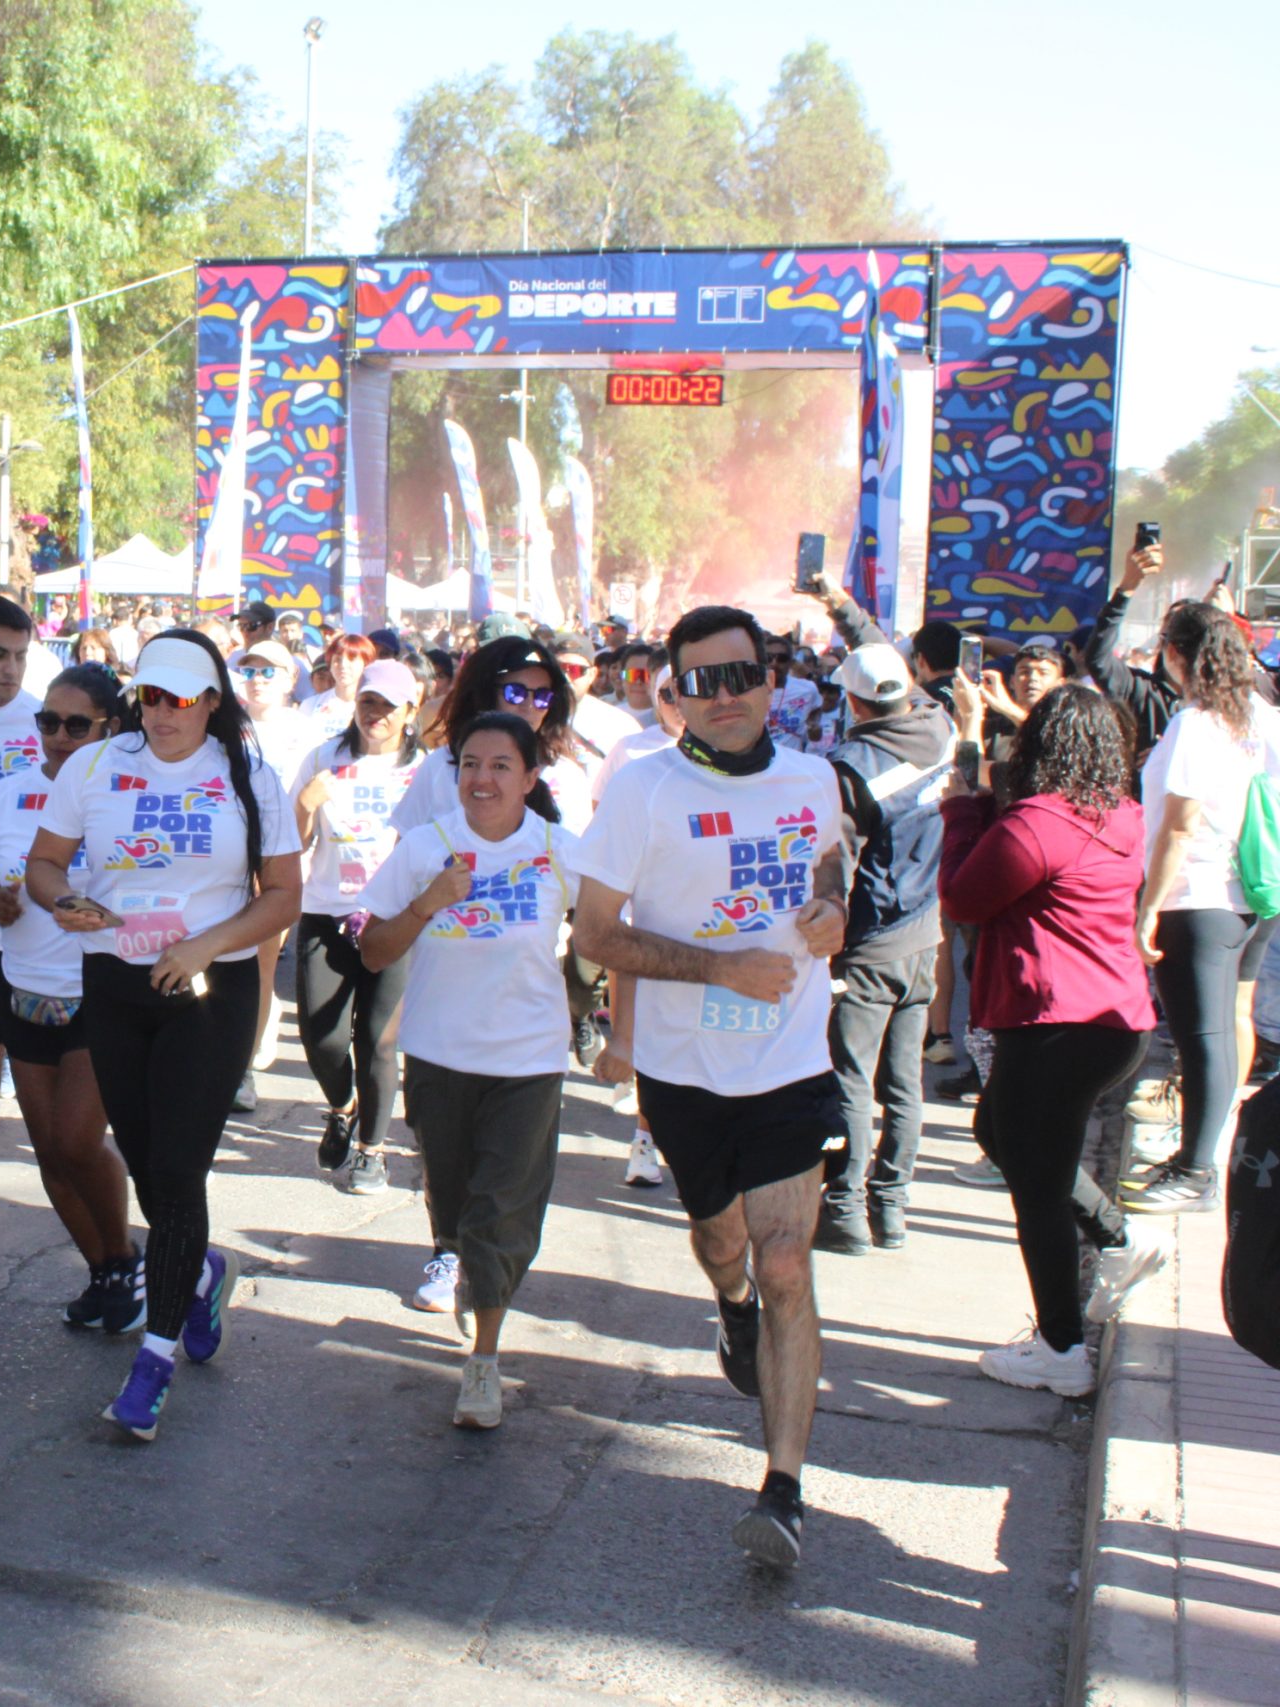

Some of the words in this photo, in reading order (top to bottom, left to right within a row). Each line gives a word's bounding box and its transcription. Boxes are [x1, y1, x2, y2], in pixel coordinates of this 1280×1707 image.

[508, 280, 529, 292] Día
[531, 279, 585, 292] Nacional
[587, 279, 607, 291] del
[508, 292, 677, 318] DEPORTE
[611, 376, 721, 403] 00:00:22
[135, 795, 182, 813] DE
[353, 786, 385, 799] DE
[132, 813, 213, 833] POR
[170, 834, 213, 855] TE
[730, 841, 778, 868] DE
[730, 863, 808, 891] POR
[768, 885, 806, 911] TE
[499, 902, 539, 922] TE
[702, 1001, 781, 1032] 3318
